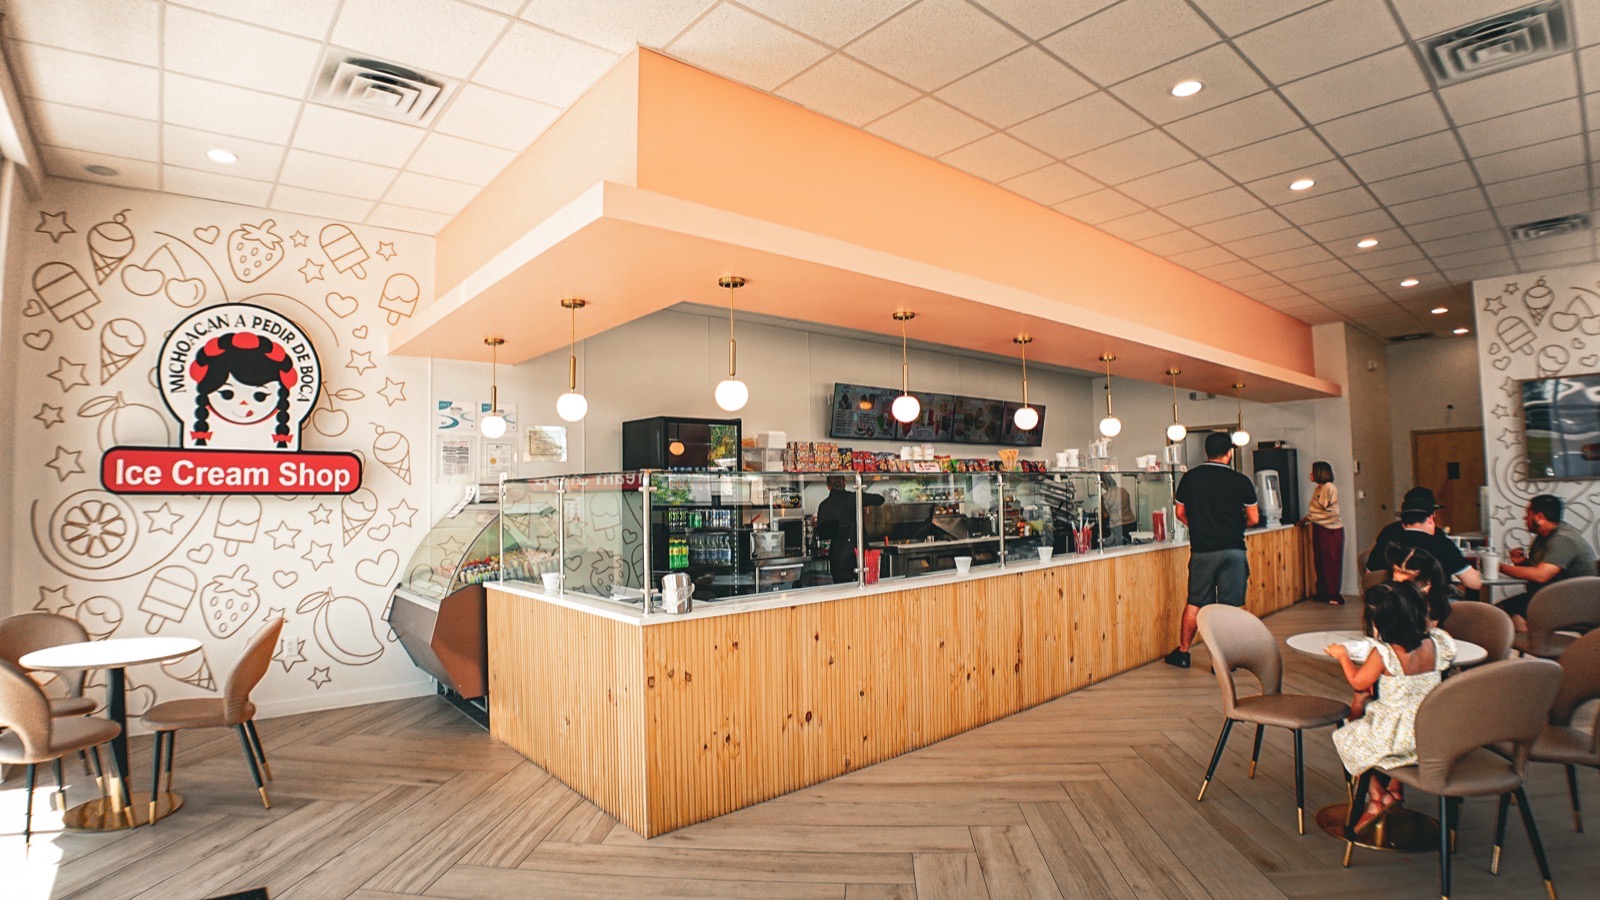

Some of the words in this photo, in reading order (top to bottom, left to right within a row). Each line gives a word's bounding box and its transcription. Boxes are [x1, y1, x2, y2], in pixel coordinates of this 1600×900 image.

[234, 314, 246, 328] A
[251, 315, 296, 344] PEDIR
[169, 313, 230, 393] MICHOACAN
[291, 343, 311, 363] DE
[296, 365, 315, 402] BOCA
[115, 459, 162, 485] Ice
[171, 460, 270, 486] Cream
[278, 462, 350, 492] Shop
